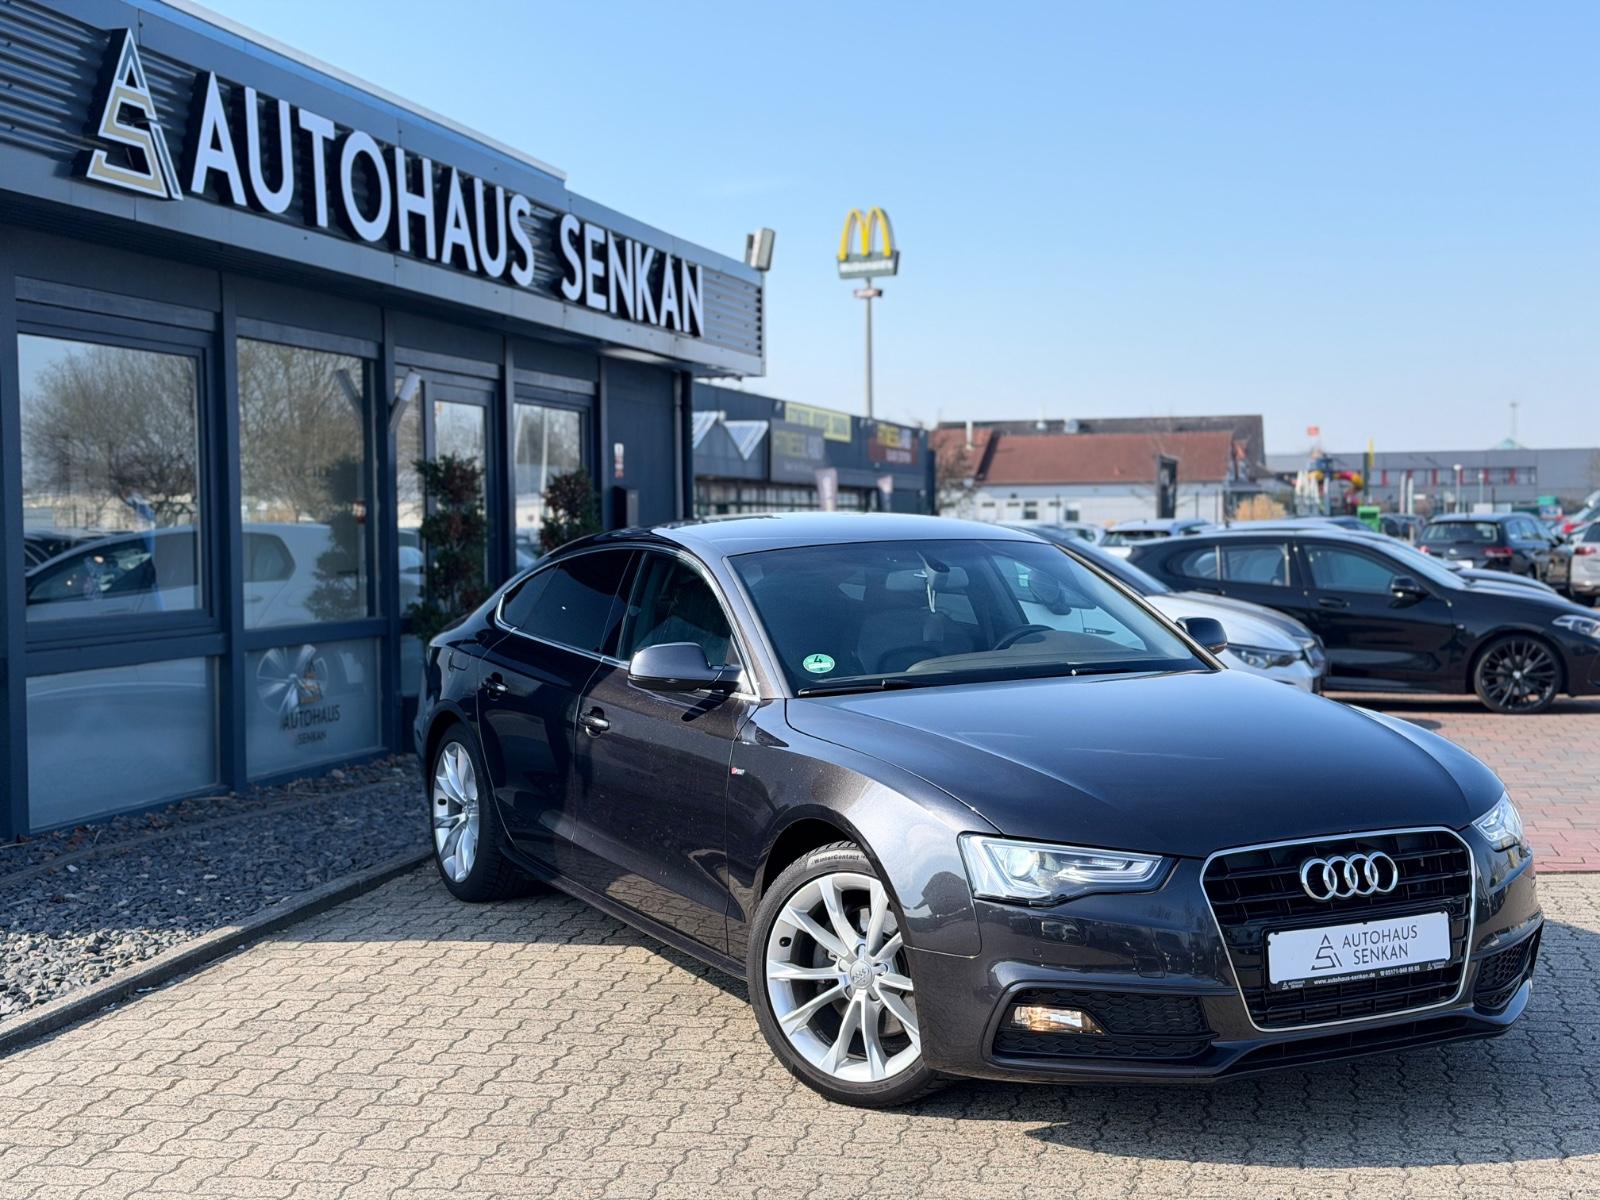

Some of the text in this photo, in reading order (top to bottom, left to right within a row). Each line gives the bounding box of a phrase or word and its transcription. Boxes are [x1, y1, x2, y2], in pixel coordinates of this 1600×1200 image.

[191, 71, 703, 337] AUTOHAUS SENKAN
[814, 655, 823, 663] 4
[282, 704, 341, 731] AUTOHAUS
[1342, 925, 1418, 949] AUTOHAUS
[1353, 942, 1409, 965] SENKAN
